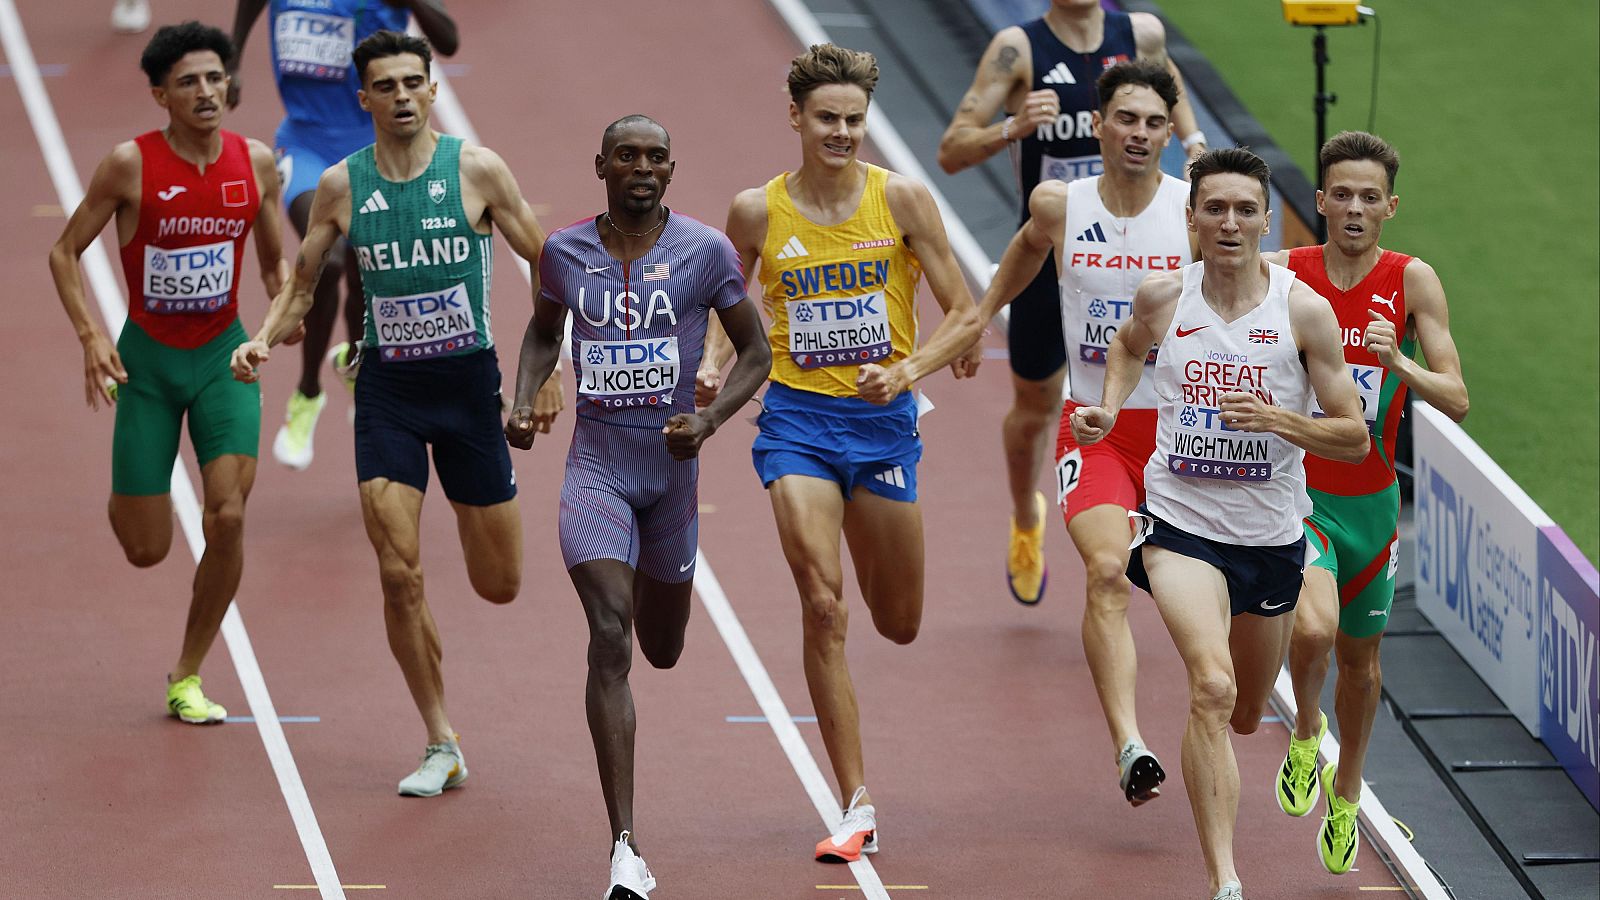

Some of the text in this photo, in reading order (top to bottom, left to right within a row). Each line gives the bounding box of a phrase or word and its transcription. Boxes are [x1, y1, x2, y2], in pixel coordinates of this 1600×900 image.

[295, 16, 345, 38] TDK
[1036, 110, 1093, 141] NOR
[1067, 160, 1105, 177] TD
[158, 216, 245, 238] MOROCCO
[421, 216, 457, 230] 123.ie
[852, 238, 896, 250] BAUHAUS
[168, 247, 227, 271] TDK
[1071, 253, 1181, 270] FRANCE
[150, 270, 229, 295] ESSAYI
[781, 259, 890, 298] SWEDEN
[396, 290, 462, 317] TDK
[578, 287, 677, 331] USA
[812, 295, 879, 321] TDK
[381, 311, 470, 341] COSCORAN
[794, 322, 886, 351] PIHLSTRÖM
[603, 341, 671, 365] TDK
[1203, 350, 1248, 363] Novuna
[1184, 360, 1268, 388] GREAT
[1174, 432, 1268, 461] WIGHTMAN
[1059, 459, 1078, 492] 12
[1431, 466, 1476, 634] TDK
[1552, 586, 1596, 769] TDK
